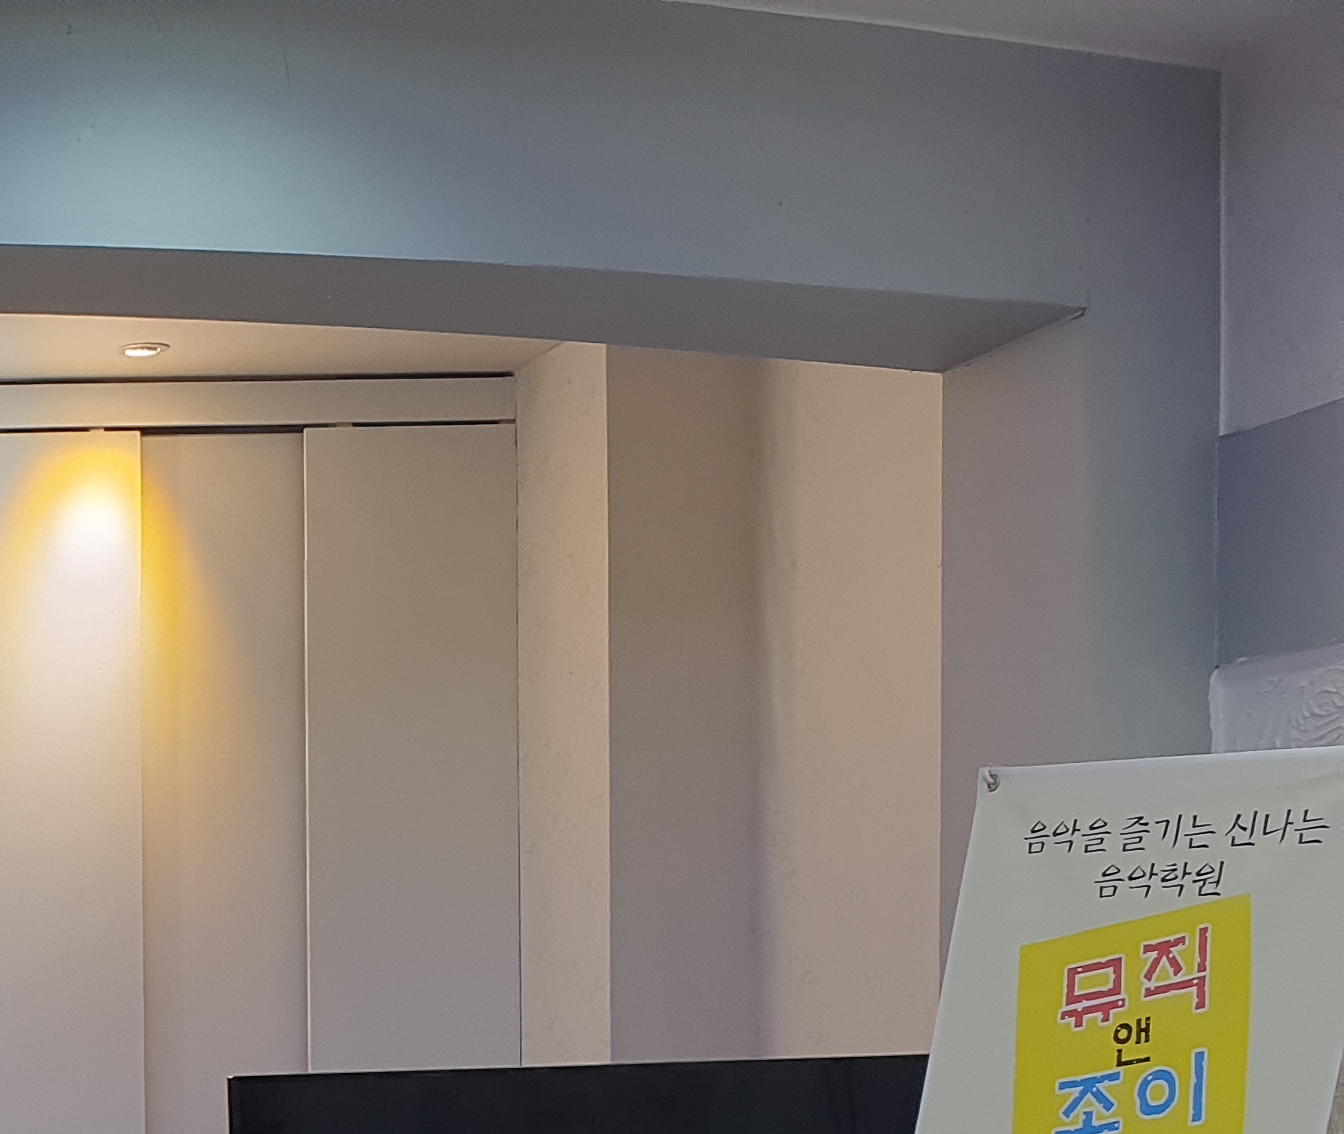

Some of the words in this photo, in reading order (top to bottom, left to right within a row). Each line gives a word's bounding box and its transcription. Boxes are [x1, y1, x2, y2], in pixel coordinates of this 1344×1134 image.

[1023, 816, 1112, 855] 음악을
[1119, 812, 1217, 852] 즐기는
[1224, 807, 1330, 849] 신나는
[1094, 860, 1225, 899] 음악학원
[1059, 925, 1210, 1030] 뮤직
[1112, 1016, 1152, 1068] 앤
